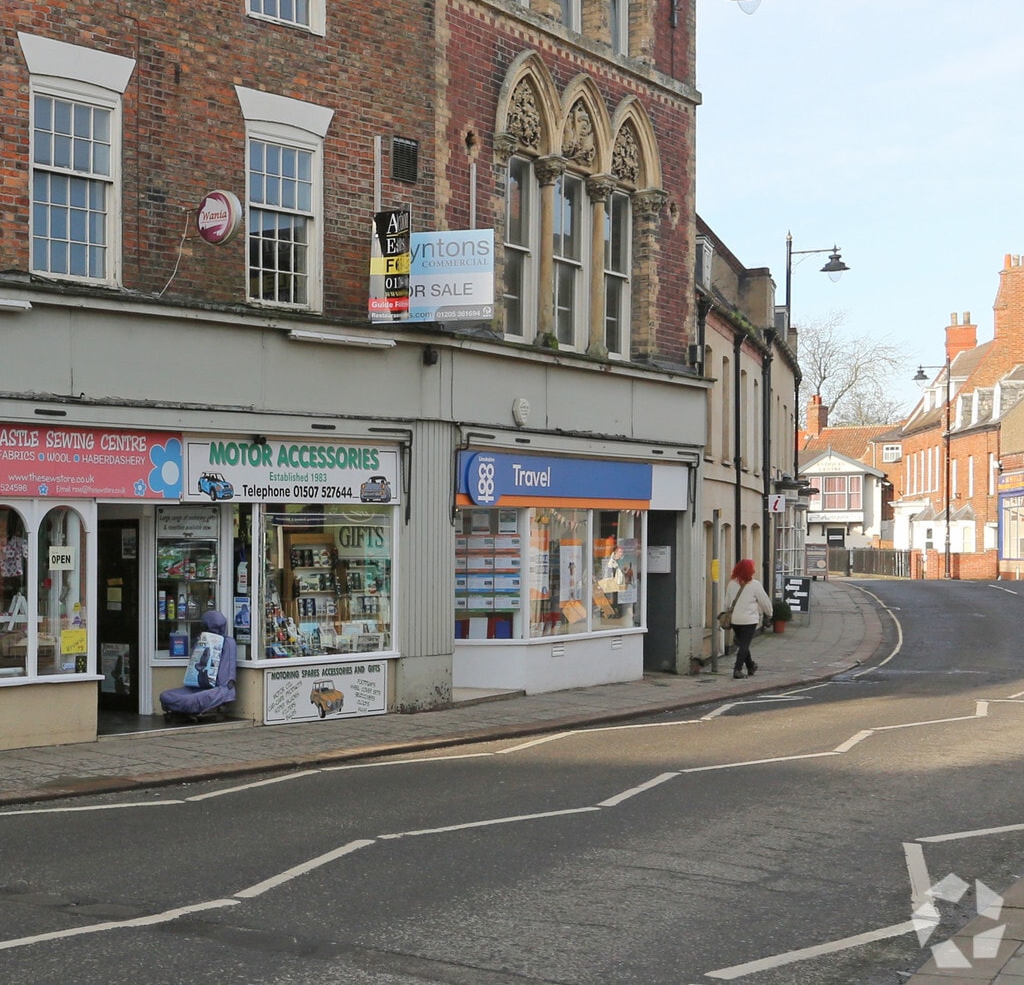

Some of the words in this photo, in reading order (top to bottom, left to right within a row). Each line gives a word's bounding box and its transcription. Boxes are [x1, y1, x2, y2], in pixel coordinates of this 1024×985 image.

[421, 258, 489, 269] COMMERCIAL
[430, 282, 473, 297] SALE
[45, 430, 95, 450] SEWING
[100, 434, 147, 452] CENTRE
[46, 452, 72, 463] WOOL
[81, 454, 146, 466] HABERDASHERY
[209, 441, 273, 466] MOTOR
[277, 444, 380, 471] ACCESSORIES
[8, 471, 95, 484] www.thesewstore.co.uk
[269, 471, 309, 483] Established
[310, 472, 328, 483] 1983
[512, 464, 551, 487] Travel
[242, 484, 291, 500] Telephone
[293, 485, 319, 499] 01507
[321, 486, 353, 500] 527644
[338, 525, 385, 549] GIFTS
[51, 554, 71, 564] OPEN
[271, 670, 300, 681] MOTORING
[301, 668, 320, 678] SPARES
[321, 666, 353, 677] ACCESSORIES
[354, 665, 365, 674] AND
[367, 664, 381, 673] GIFTS
